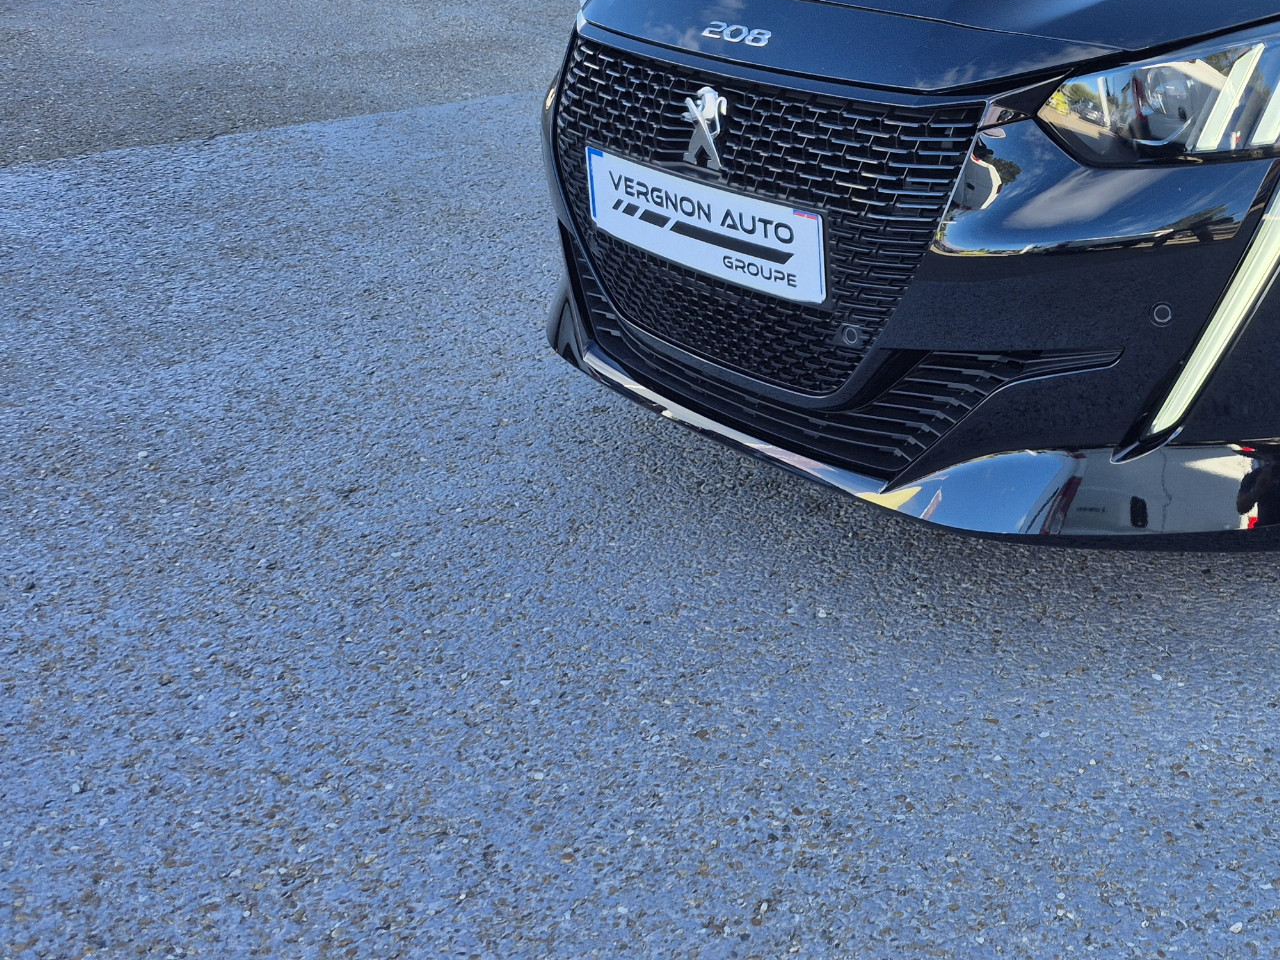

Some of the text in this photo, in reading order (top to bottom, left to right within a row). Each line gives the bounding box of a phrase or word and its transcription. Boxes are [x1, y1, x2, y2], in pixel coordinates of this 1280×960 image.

[701, 20, 772, 47] 208
[608, 170, 795, 245] VERGNON AUTO
[722, 254, 798, 289] GROUPE
